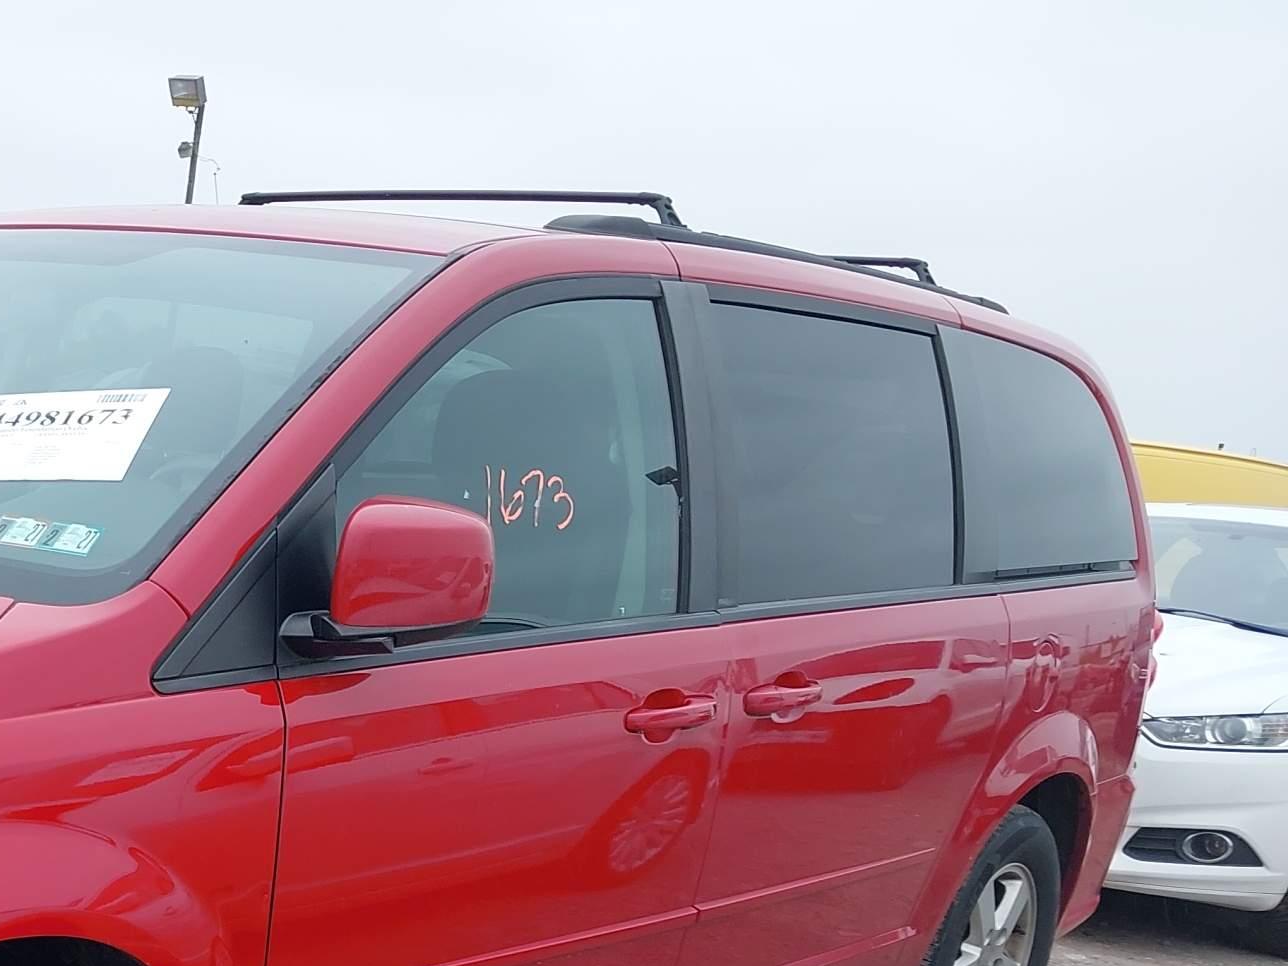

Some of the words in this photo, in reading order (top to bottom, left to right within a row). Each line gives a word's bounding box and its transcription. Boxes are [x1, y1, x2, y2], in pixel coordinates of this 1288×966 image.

[485, 464, 574, 530] 1673
[23, 523, 46, 543] 27
[42, 528, 60, 547] 2
[76, 530, 98, 551] 27
